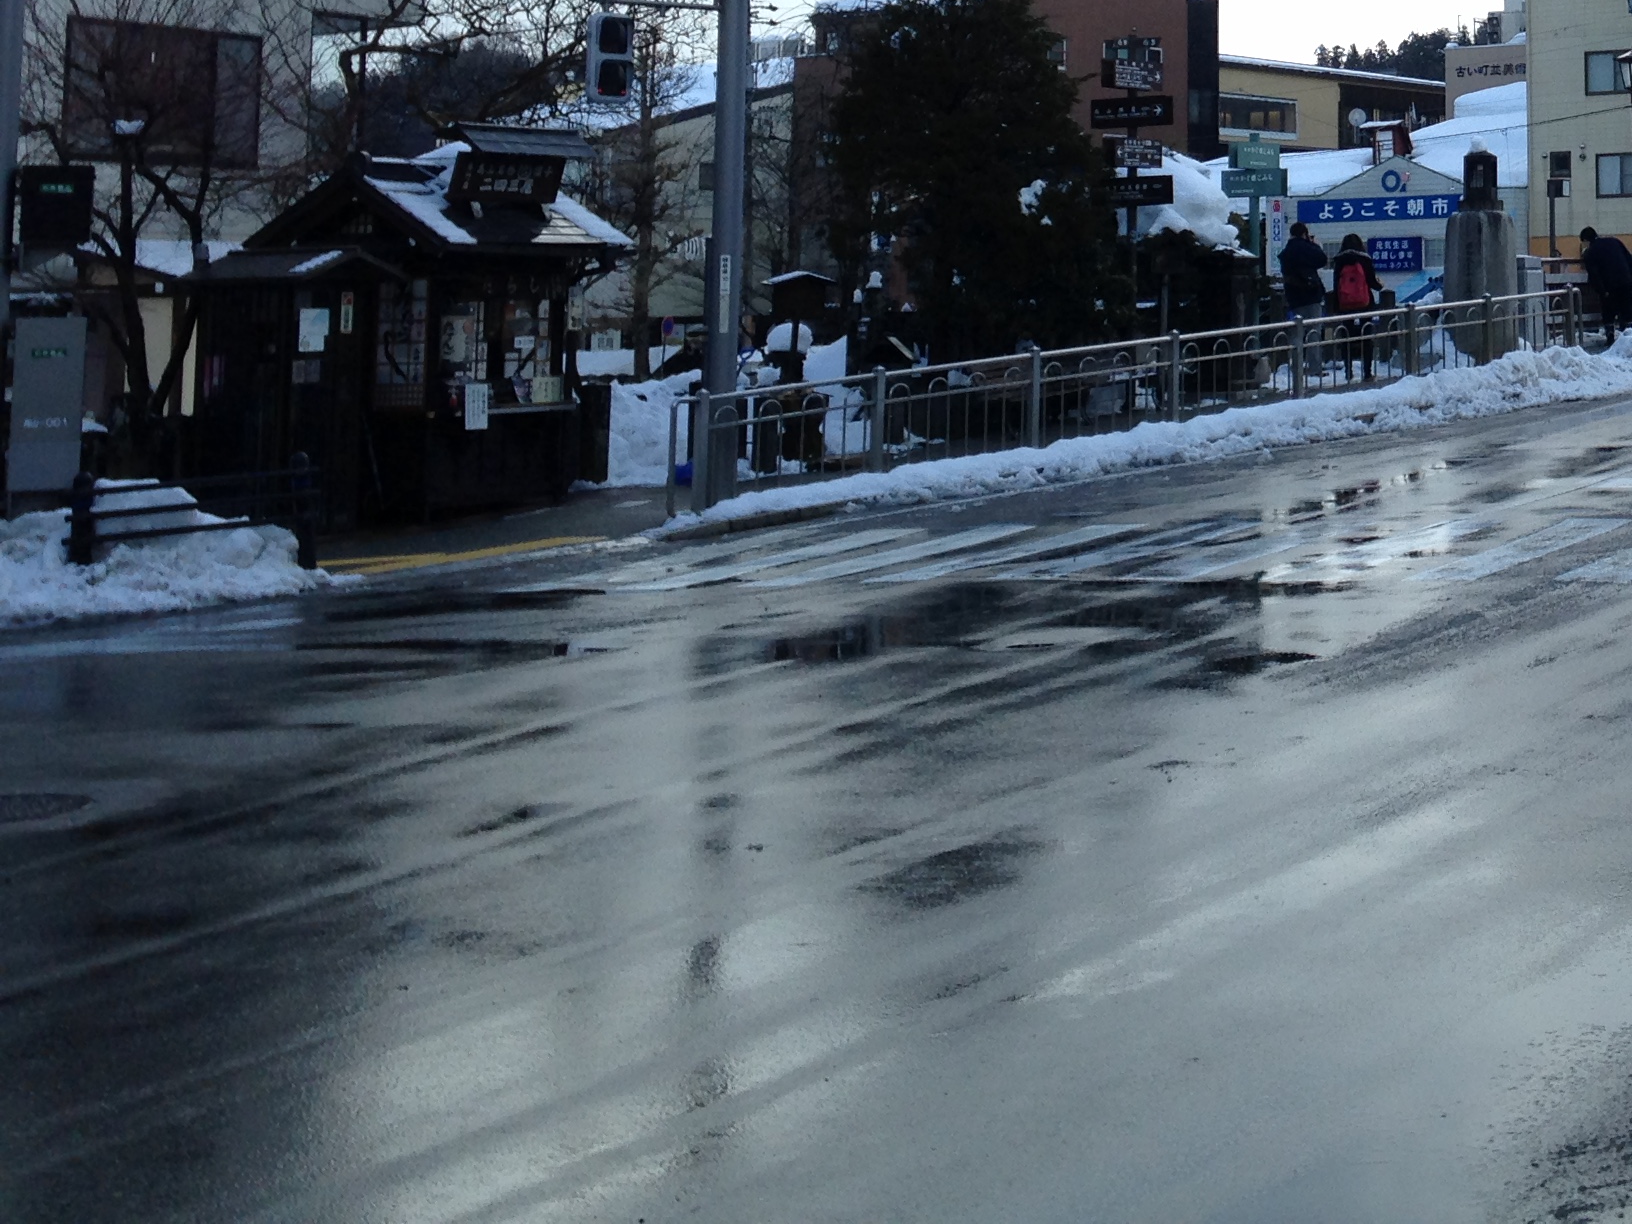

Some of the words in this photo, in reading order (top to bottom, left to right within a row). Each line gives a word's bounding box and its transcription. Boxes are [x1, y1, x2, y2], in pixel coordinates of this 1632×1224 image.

[1318, 197, 1449, 220] ようこそ朝市
